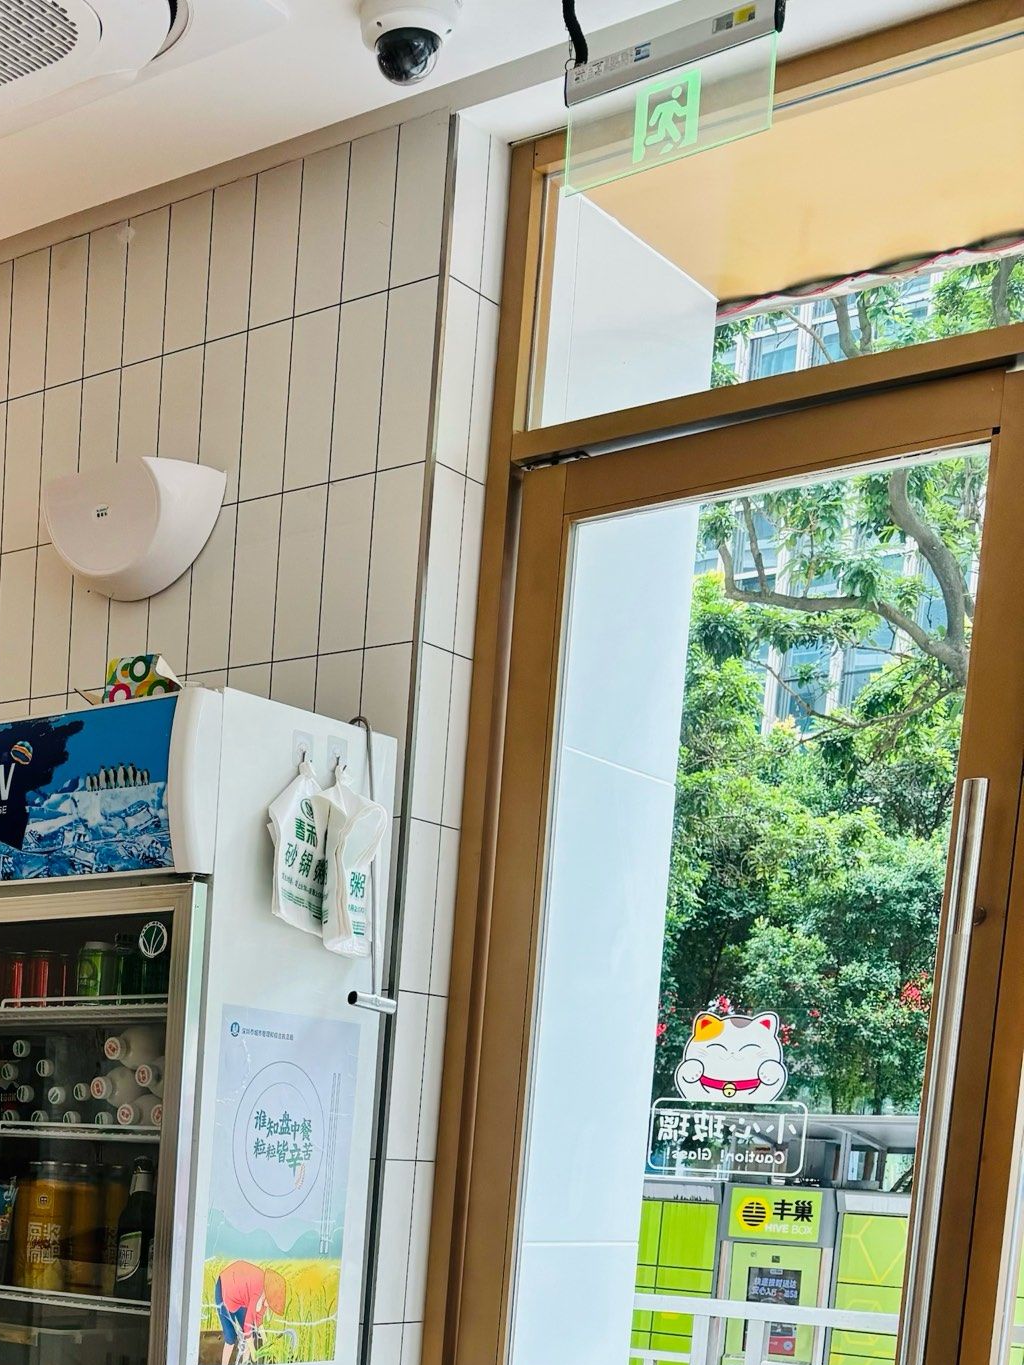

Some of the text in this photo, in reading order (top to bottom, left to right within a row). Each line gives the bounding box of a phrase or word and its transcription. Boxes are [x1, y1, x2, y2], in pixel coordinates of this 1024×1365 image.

[349, 871, 367, 899] 粥
[254, 1109, 312, 1141] 谁知盘中餐
[253, 1138, 313, 1177] 粒粒皆辛苦
[772, 1199, 814, 1223] 丰巢
[765, 1224, 813, 1235] HIVE BOX
